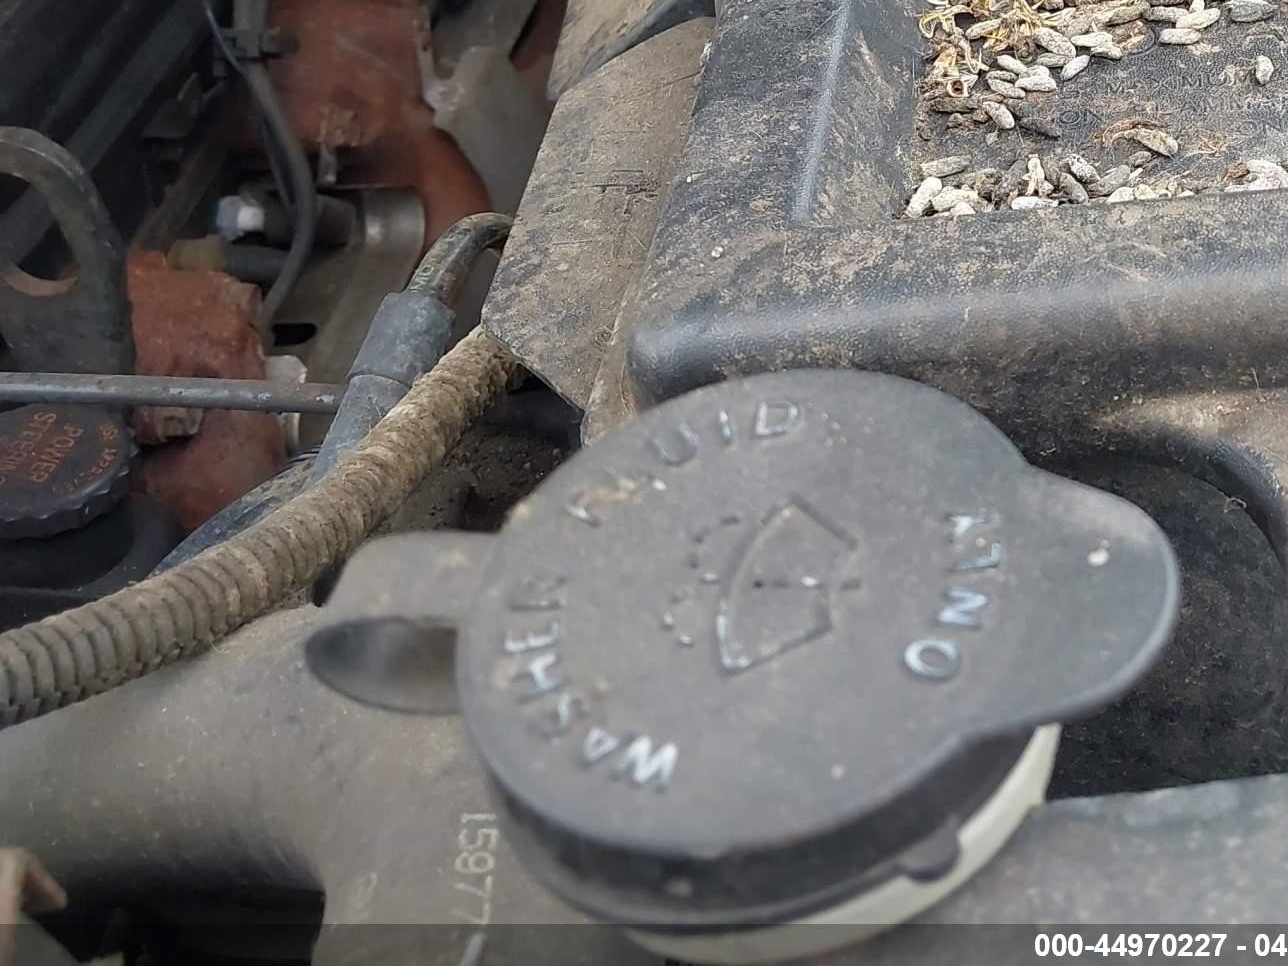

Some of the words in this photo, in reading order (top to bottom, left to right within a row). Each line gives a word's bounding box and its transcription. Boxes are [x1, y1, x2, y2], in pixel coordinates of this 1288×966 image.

[31, 422, 84, 483] POWER
[503, 573, 679, 791] WASHER
[903, 510, 1001, 682] ONLY
